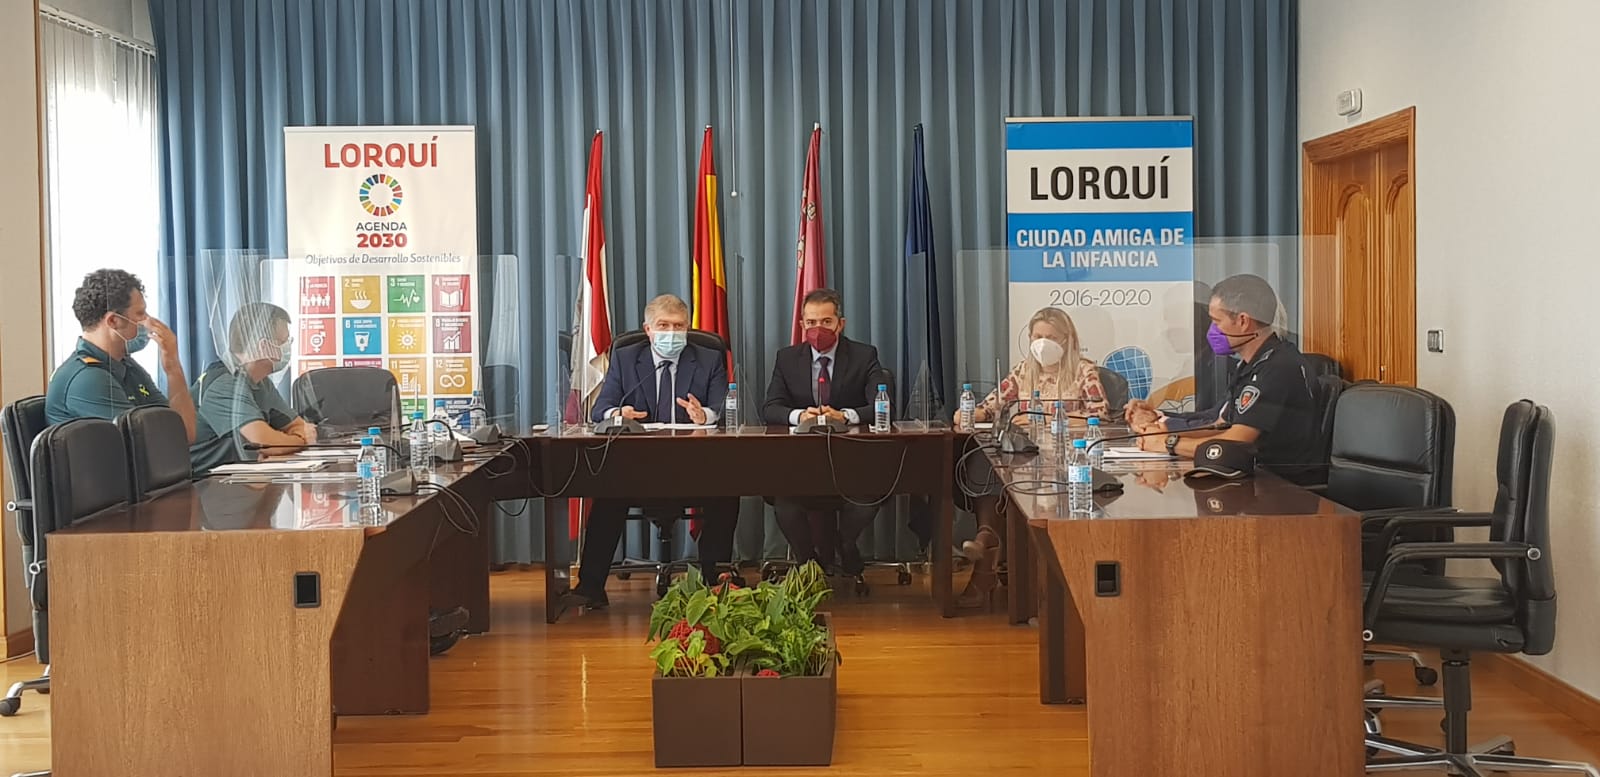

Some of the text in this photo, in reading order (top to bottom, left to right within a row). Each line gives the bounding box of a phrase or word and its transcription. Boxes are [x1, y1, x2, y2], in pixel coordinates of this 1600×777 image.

[324, 136, 438, 168] LORQUÍ
[1030, 156, 1170, 201] LORQUÍ
[356, 222, 407, 231] AGENDA
[357, 233, 408, 248] 2030
[1016, 228, 1185, 247] CIUDAD AMIGA DE
[305, 253, 462, 266] Objetivos de Desarrollo Sostenibles
[1042, 252, 1159, 268] LA INFANCIA
[344, 278, 351, 288] 2
[390, 277, 396, 287] 3
[1049, 290, 1152, 307] 2016-2020
[390, 318, 396, 328] 7
[435, 359, 443, 368] 12
